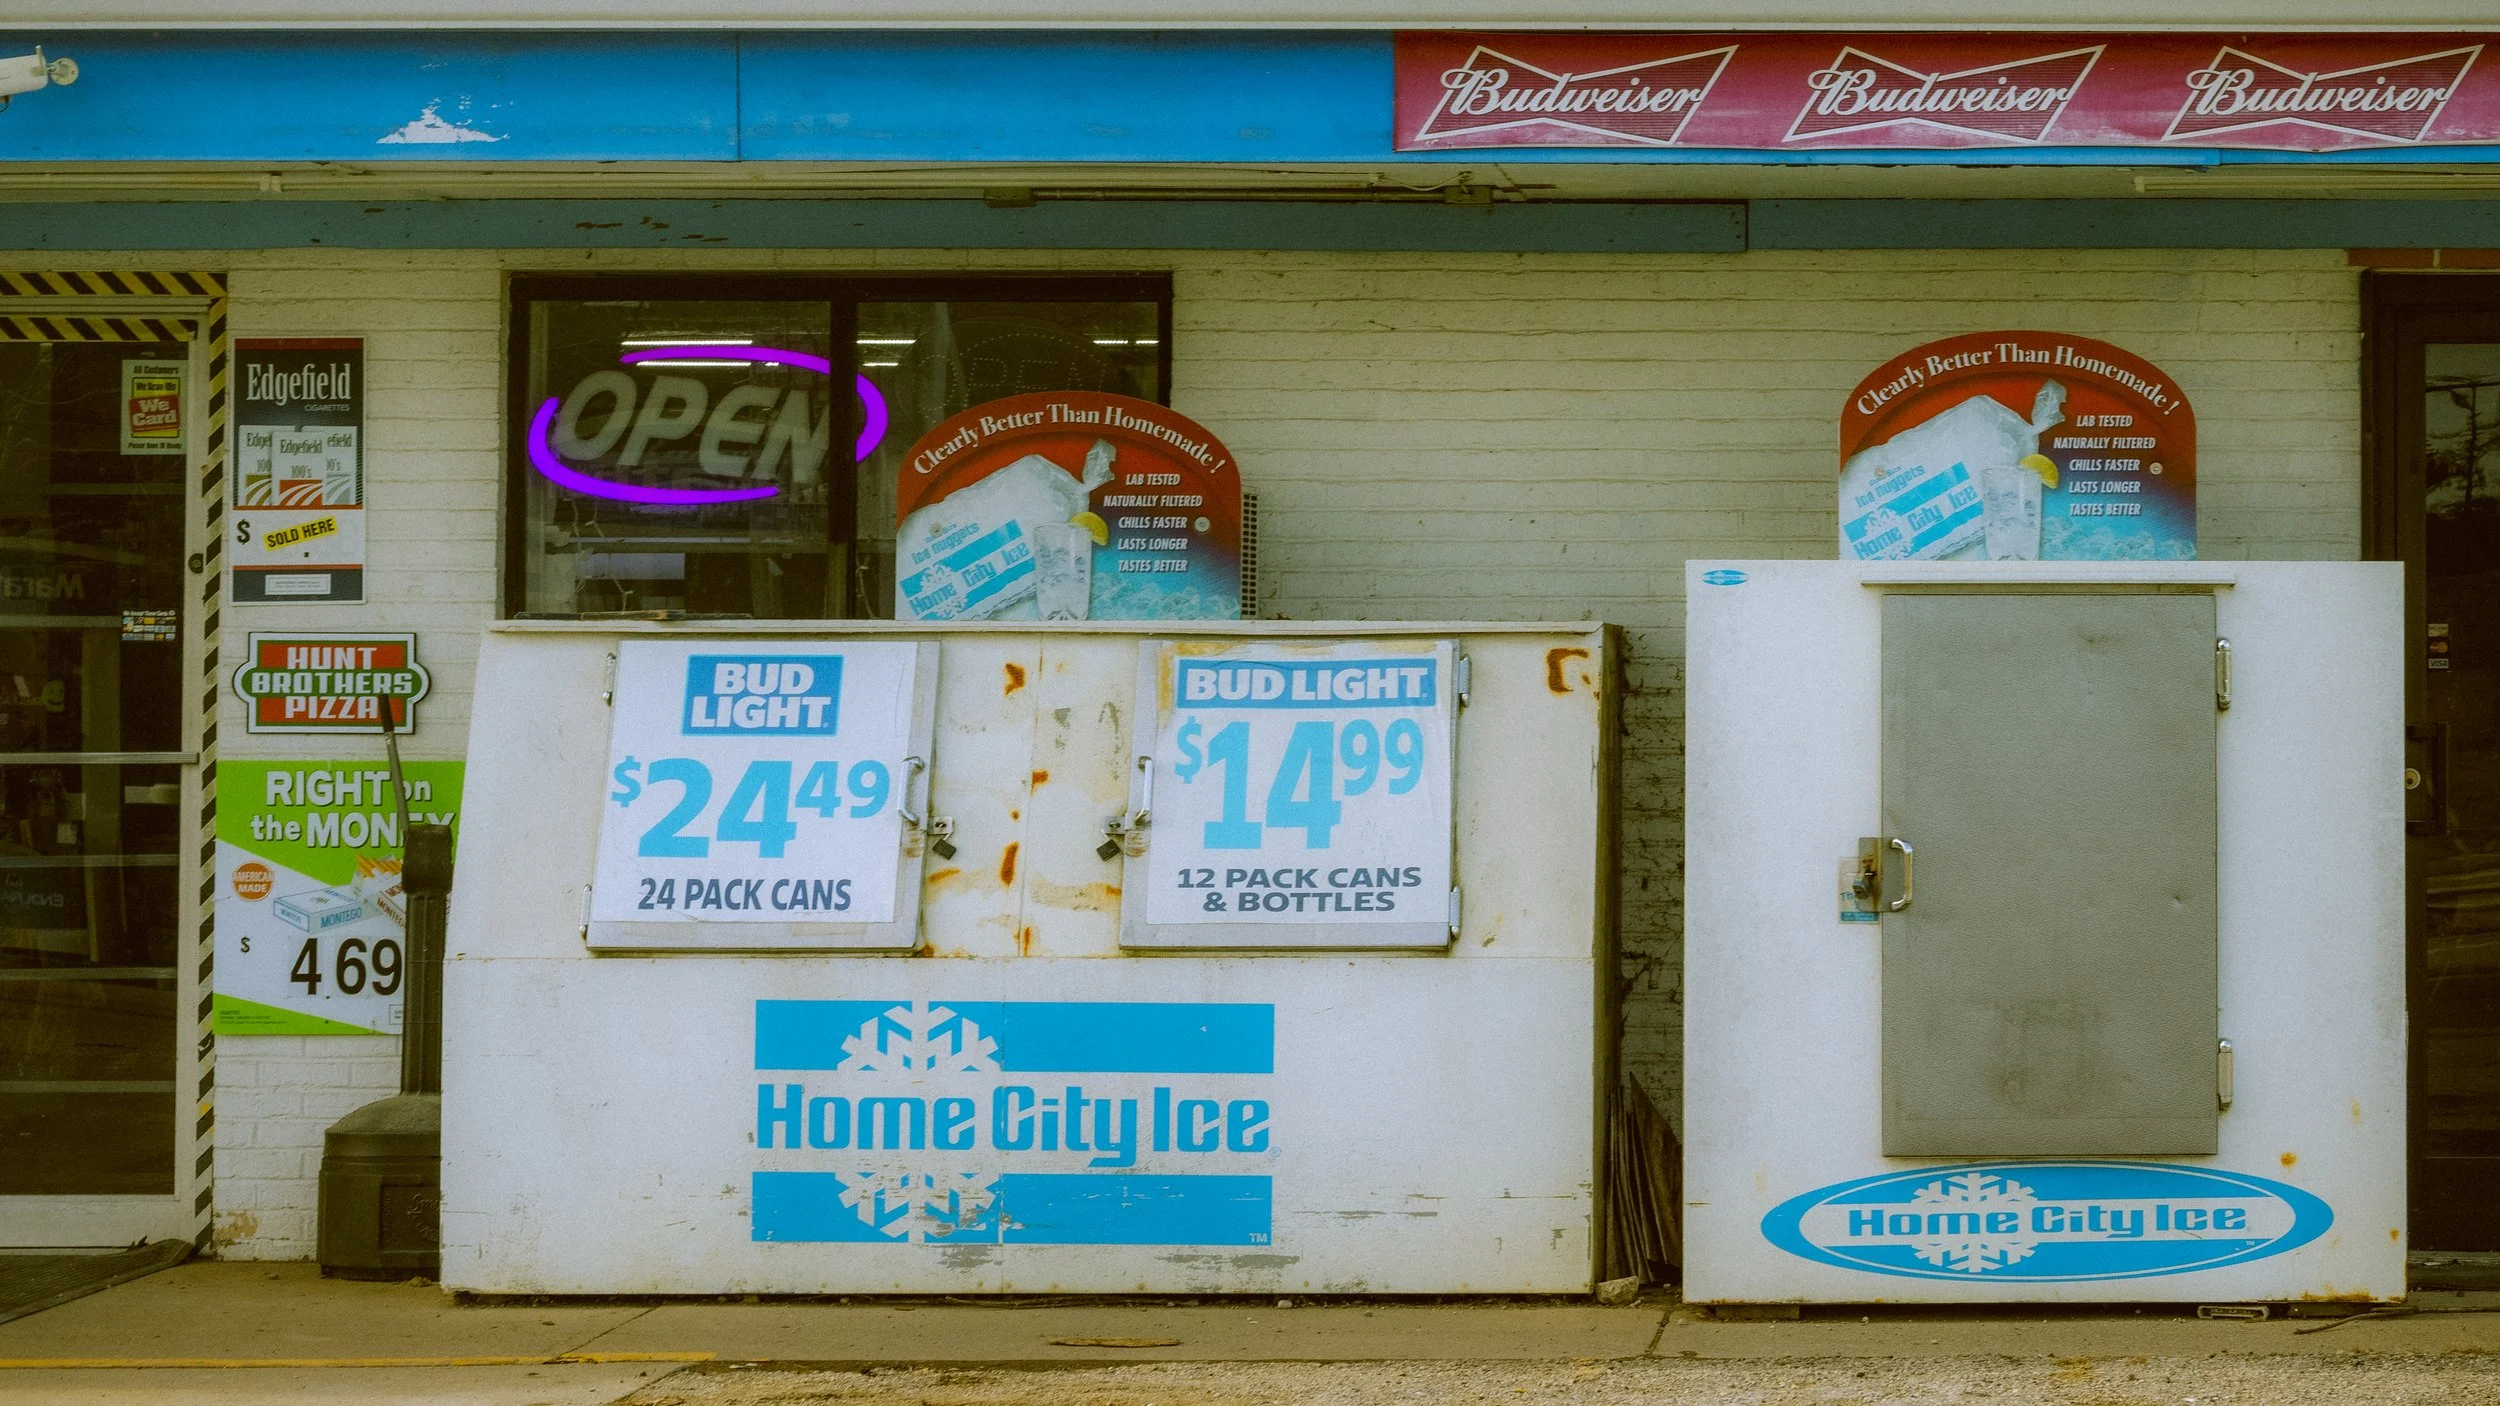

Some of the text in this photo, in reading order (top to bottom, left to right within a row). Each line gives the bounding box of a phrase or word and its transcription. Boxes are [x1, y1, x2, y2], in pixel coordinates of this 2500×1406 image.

[1440, 68, 1703, 115] Budweiser
[1808, 68, 2071, 115] Budweiser
[2186, 67, 2450, 115] Budweiser
[145, 366, 179, 374] Customers
[1857, 366, 1925, 416] Clearly
[1925, 349, 1993, 377] Better
[1995, 343, 2050, 364] Than
[2054, 345, 2169, 407] Homemade
[246, 363, 352, 406] Edgefield
[138, 398, 170, 413] We
[132, 410, 177, 427] Card
[552, 370, 831, 484] OPEN
[2076, 415, 2132, 427] LAB TESTED
[280, 439, 323, 456] Edgefield
[913, 425, 980, 476] Clearly
[979, 408, 1044, 437] Better
[1046, 403, 1100, 424] Than
[1104, 405, 1214, 467] Homemade
[2053, 437, 2156, 449] NATURALLY FILTERED
[2069, 459, 2140, 471] CHILLS FASTER
[1125, 473, 1180, 486] LAB TESTED
[1875, 465, 1925, 496] nuggets
[2069, 481, 2141, 493] LASTS LONGER
[1103, 495, 1203, 507] NATURALLY FILTERED
[2069, 503, 2141, 516] TASTES BETTER
[236, 518, 251, 545] $
[267, 518, 335, 548] SOLD HERE
[1118, 517, 1188, 529] CHILLS FASTER
[1853, 485, 1979, 560] Home City Ice
[931, 522, 981, 554] nuggets
[1118, 538, 1188, 551] LASTS LONGER
[1118, 560, 1188, 573] TASTES BETTER
[909, 542, 1030, 616] Home City Ice
[287, 647, 377, 670] HUNT
[252, 672, 412, 693] BROTHERS
[713, 663, 815, 695] BUD
[1185, 667, 1428, 700] BUD LIGHT
[285, 696, 378, 718] PIZZA
[690, 696, 832, 728] LIGHT
[266, 770, 390, 806] RIGHT
[251, 812, 455, 848] the MON
[234, 871, 274, 883] AMERICAN
[1177, 867, 1421, 888] 12 PACK CANS
[238, 884, 267, 893] MADE
[638, 877, 852, 911] 24 PACK CANS
[1202, 891, 1395, 912] & BOTTLES
[320, 907, 362, 929] MONTEGO
[240, 936, 250, 953] $
[756, 1083, 1270, 1168] Home City Ice
[1848, 1203, 2246, 1238] Home City Ice
